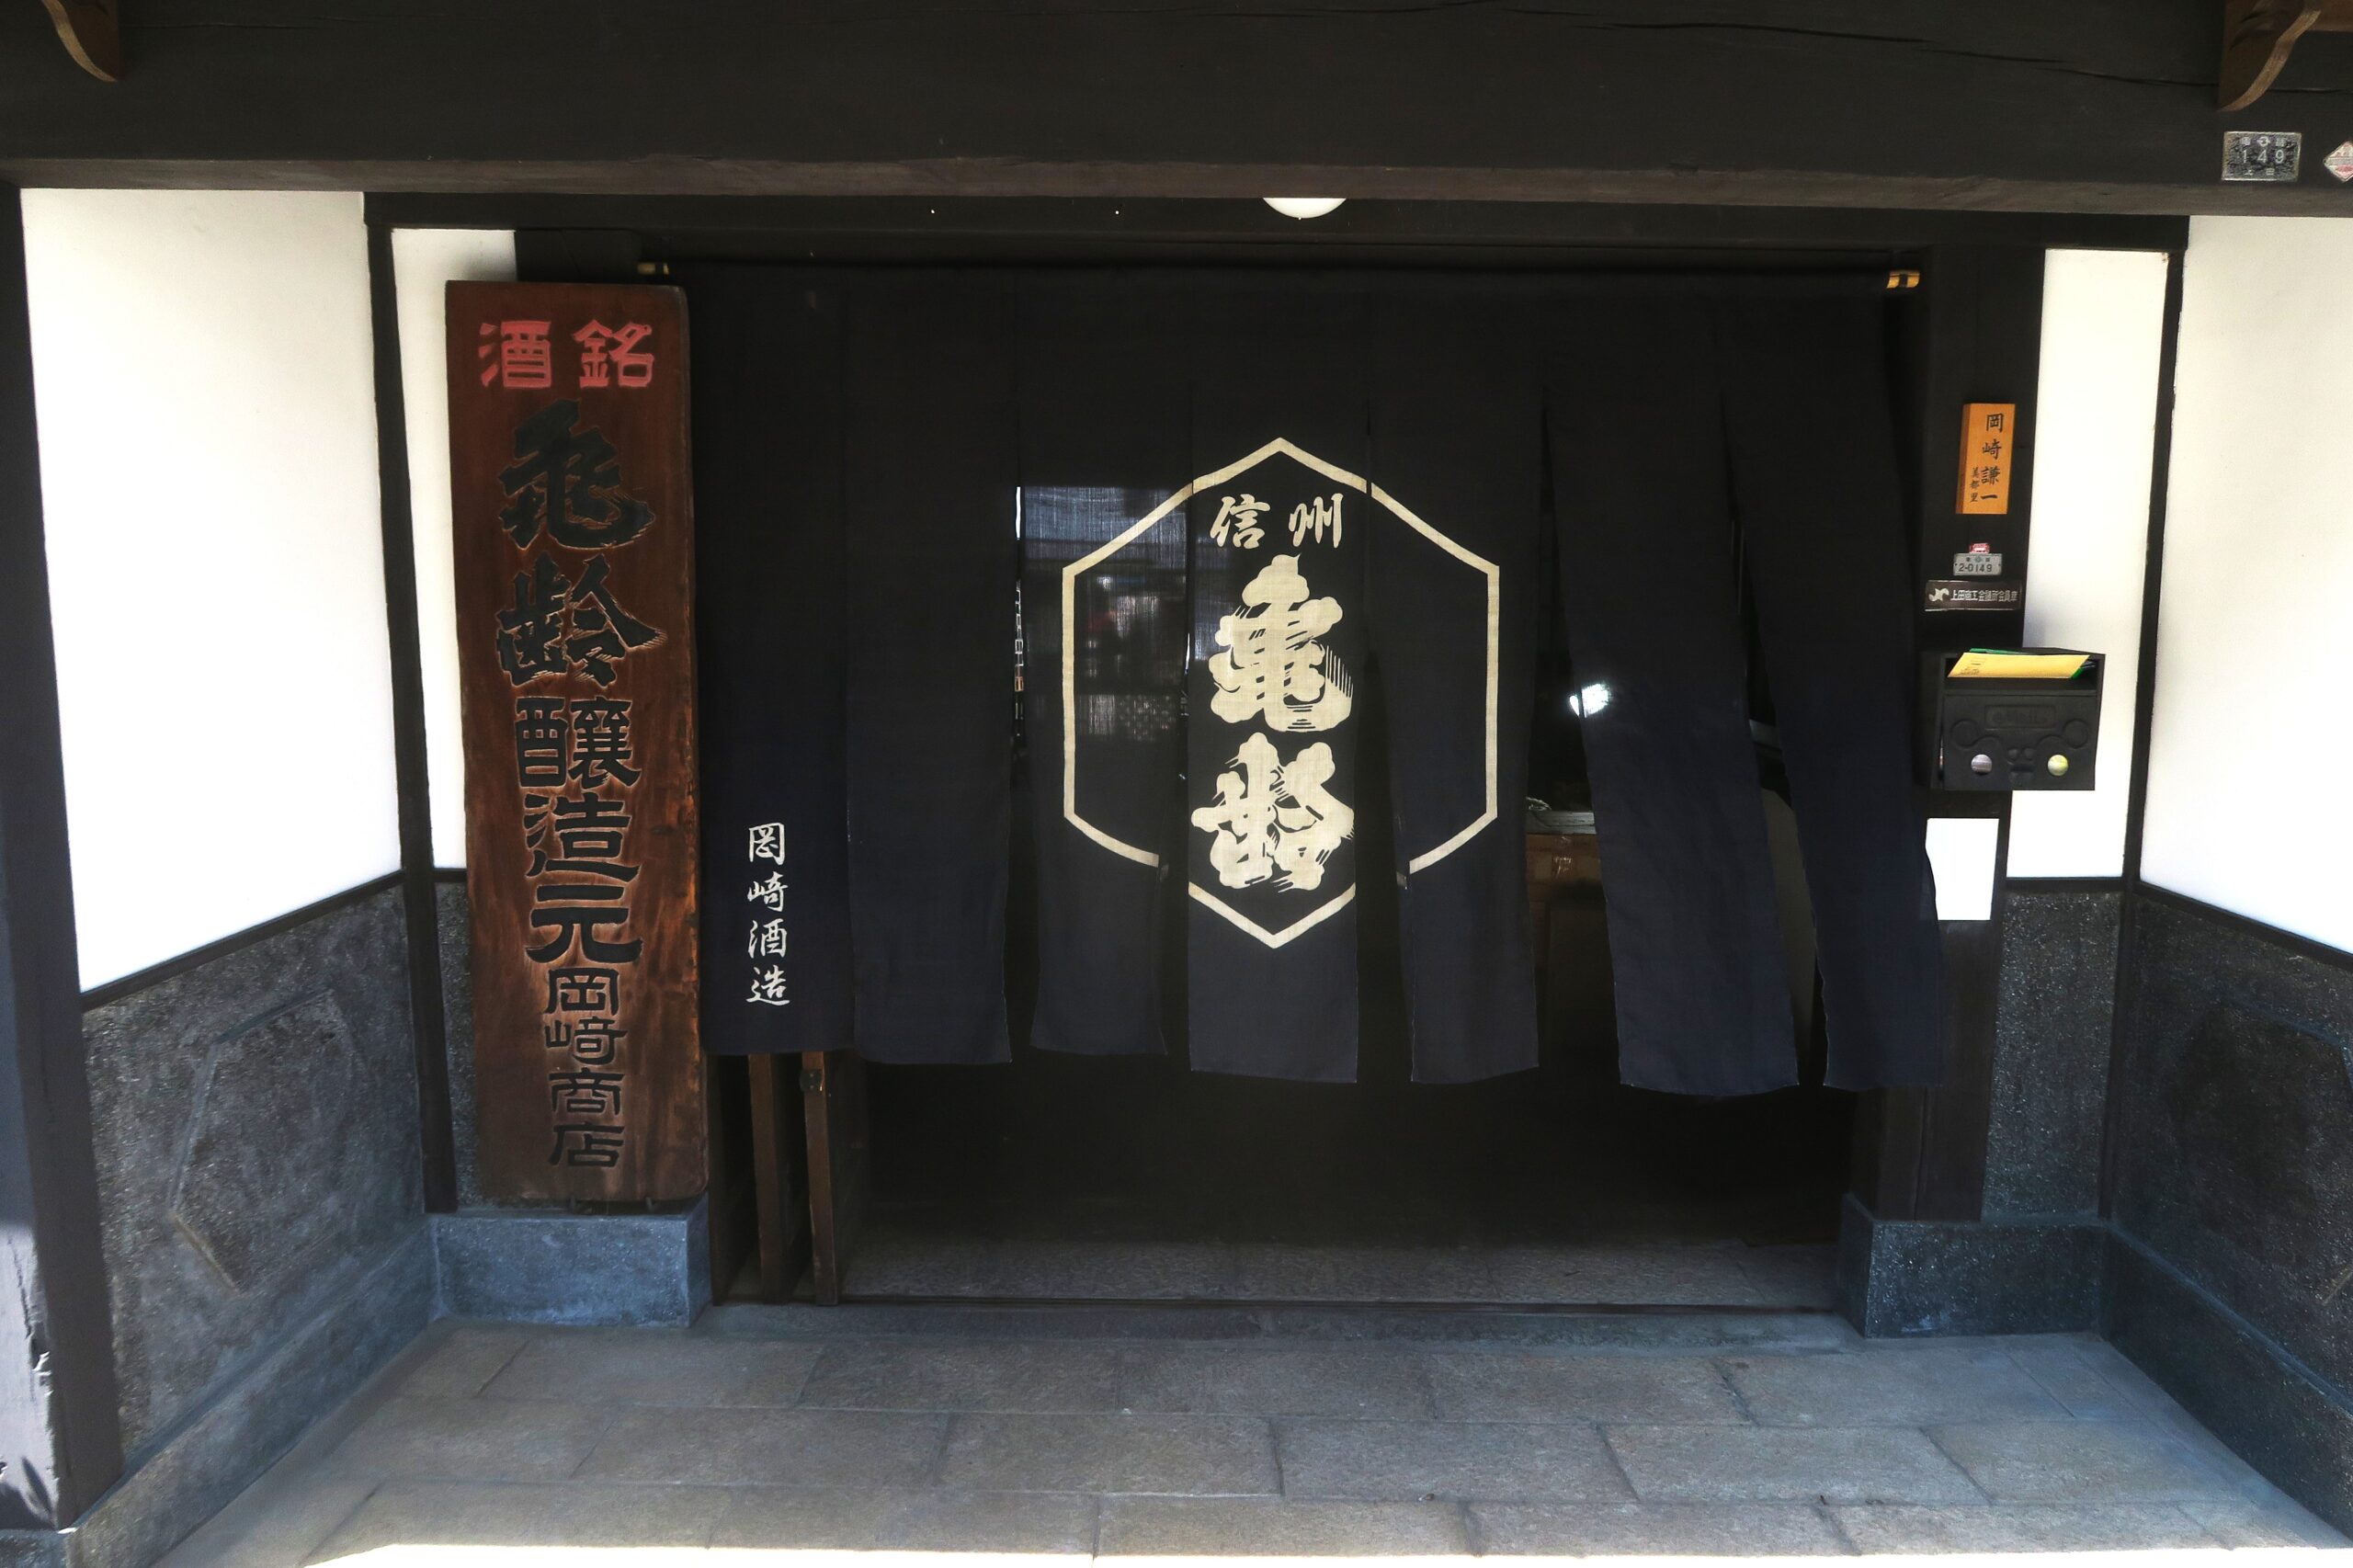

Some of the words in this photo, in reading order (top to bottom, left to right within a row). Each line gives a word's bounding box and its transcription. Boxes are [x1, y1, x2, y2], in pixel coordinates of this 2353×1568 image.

[2242, 149, 2285, 164] 149
[1210, 493, 1345, 550] 信州
[1958, 562, 1994, 574] 2-0149
